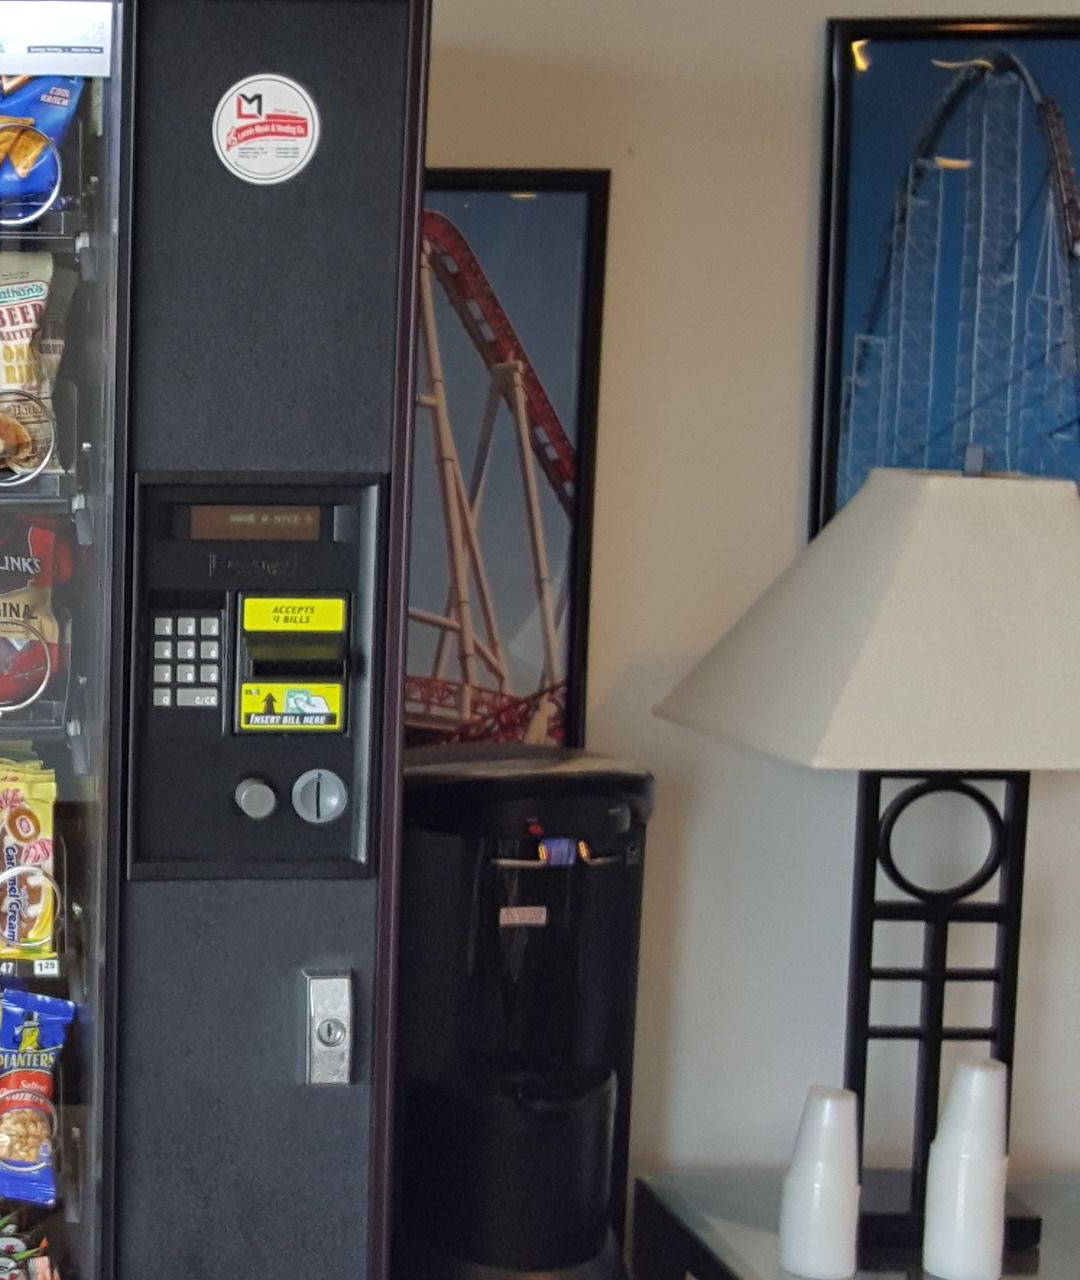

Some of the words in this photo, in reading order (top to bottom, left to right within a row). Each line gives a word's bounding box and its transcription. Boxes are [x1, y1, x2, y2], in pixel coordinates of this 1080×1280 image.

[272, 605, 316, 615] ACCEPTS
[273, 616, 280, 624] 4
[283, 616, 311, 624] BILLS
